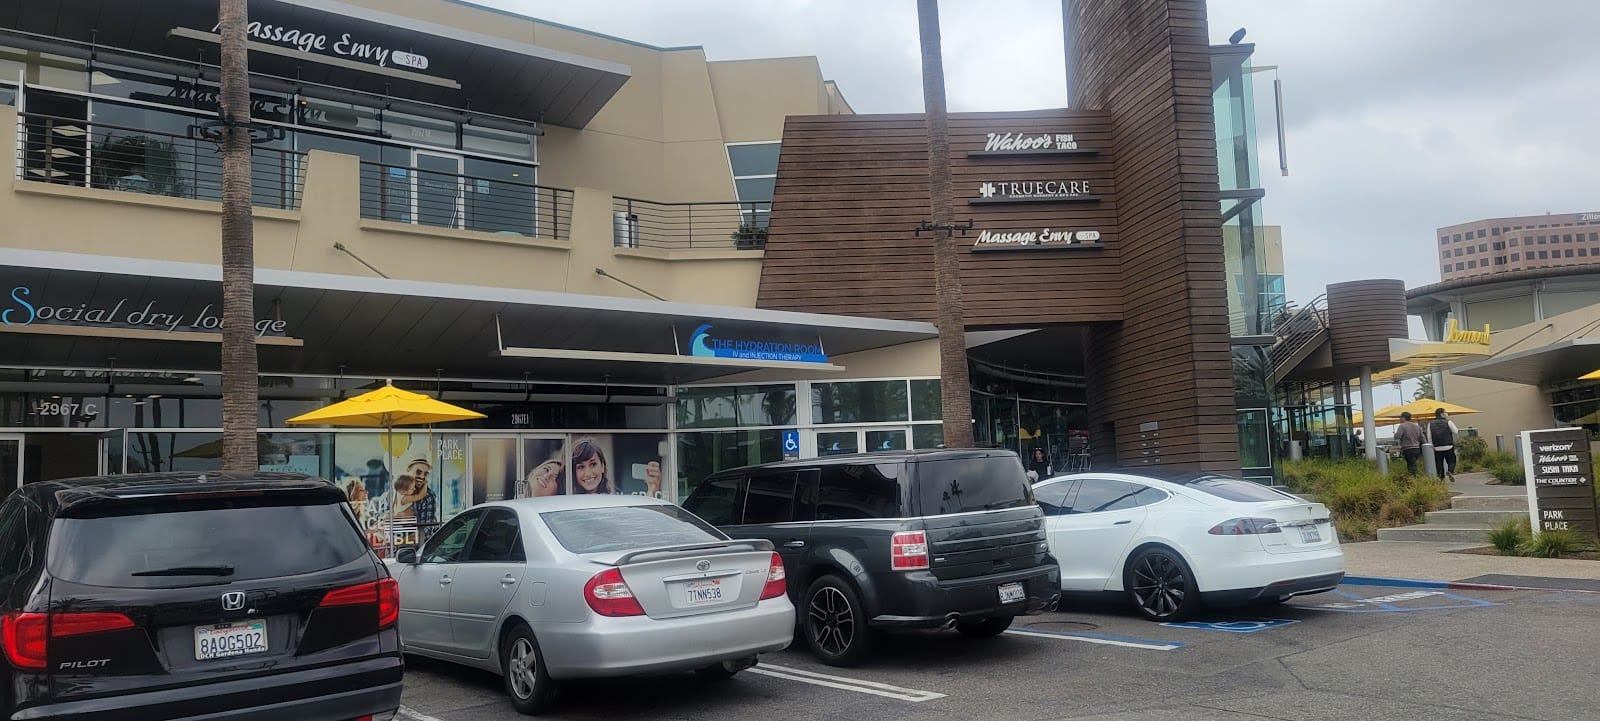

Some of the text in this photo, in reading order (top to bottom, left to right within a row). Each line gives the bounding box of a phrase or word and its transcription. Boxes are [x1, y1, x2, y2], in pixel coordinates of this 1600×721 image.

[209, 19, 424, 67] assage Envy SPA
[984, 132, 1053, 152] Wahoo's
[1055, 133, 1074, 142] FISH
[1056, 141, 1078, 150] TACO
[998, 180, 1090, 196] TRUECARE
[974, 229, 1037, 246] Massage
[1039, 228, 1073, 245] Envy
[1, 286, 288, 337] Social dry loge
[712, 339, 821, 355] THE HYDRATION ROOM
[750, 352, 778, 360] INJECTION
[779, 353, 802, 361] THERAPY
[39, 403, 97, 416] 2967 C
[437, 439, 459, 450] PARK
[1539, 442, 1574, 452] verizon
[437, 449, 463, 460] PLACE
[1541, 465, 1560, 474] SUSHI
[1543, 510, 1564, 519] PARK
[1544, 521, 1569, 531] PLACE
[687, 587, 722, 602] 7TNN538
[200, 632, 262, 655] 8AQG502
[244, 646, 265, 654] Honda
[59, 658, 111, 670] PILOT
